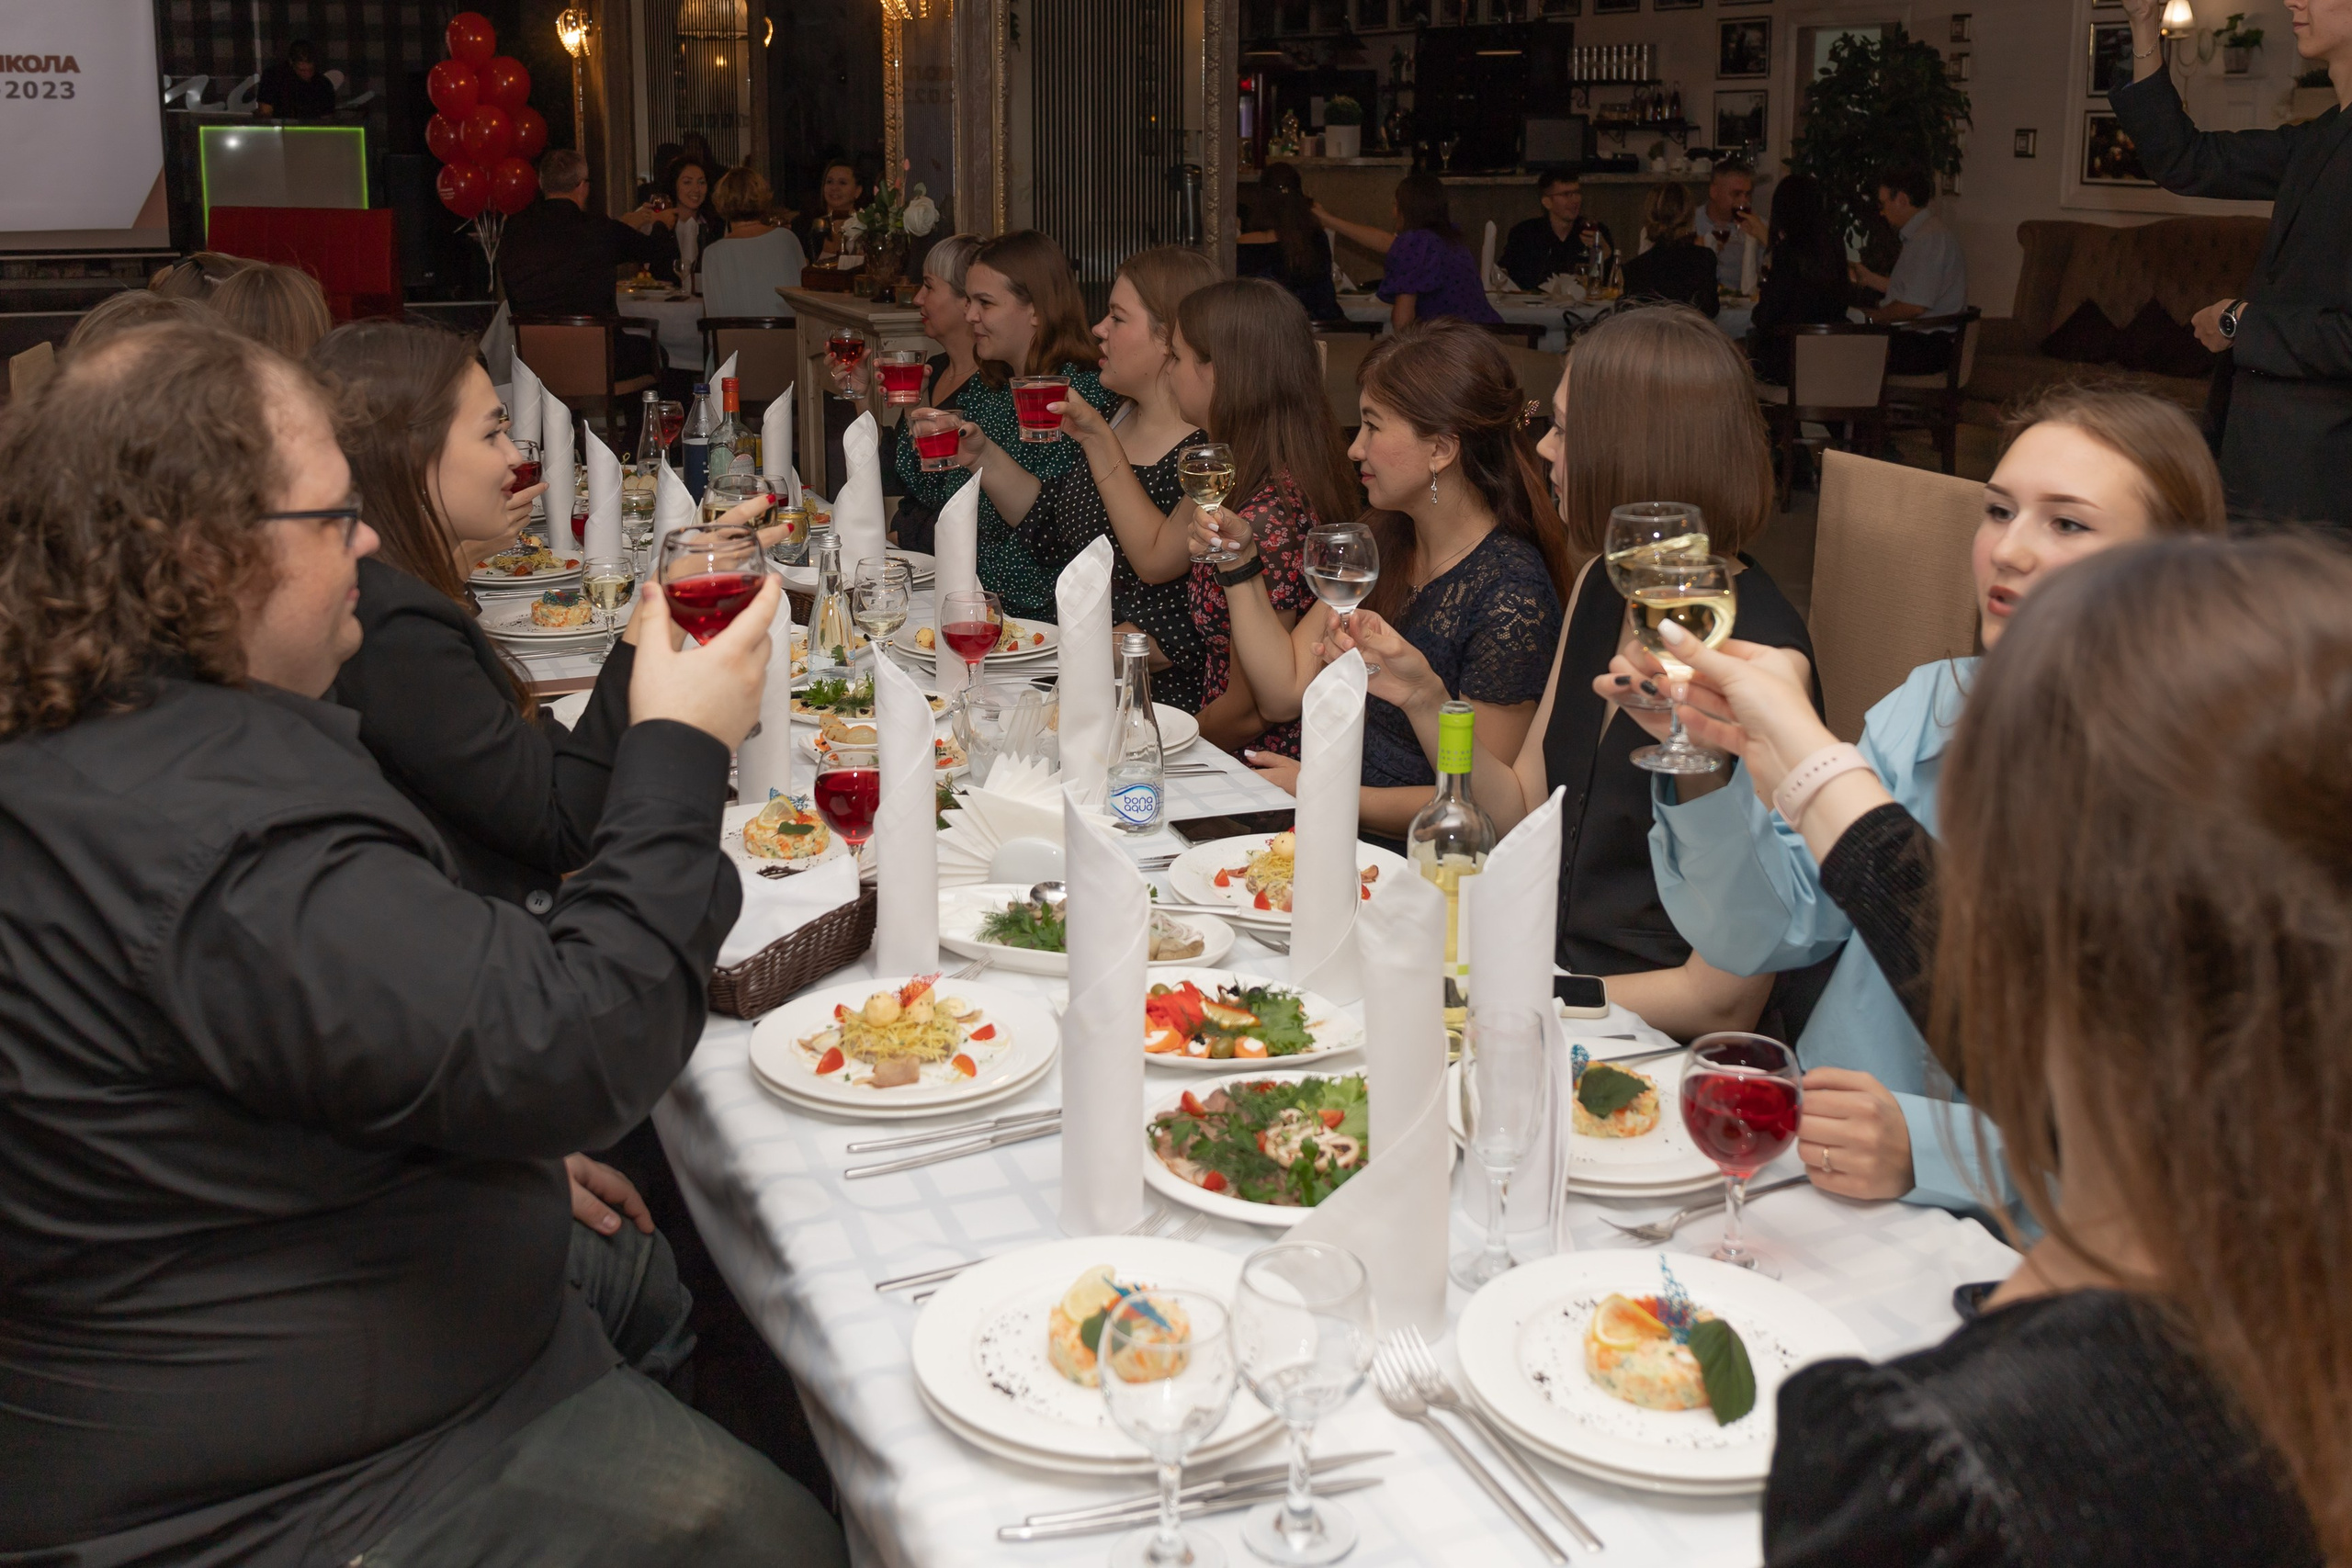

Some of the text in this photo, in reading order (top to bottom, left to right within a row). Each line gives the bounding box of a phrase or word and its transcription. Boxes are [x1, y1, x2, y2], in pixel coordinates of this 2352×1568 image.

[5, 80, 75, 100] 2023
[1124, 795, 1154, 805] bona
[1124, 803, 1153, 814] aqua
